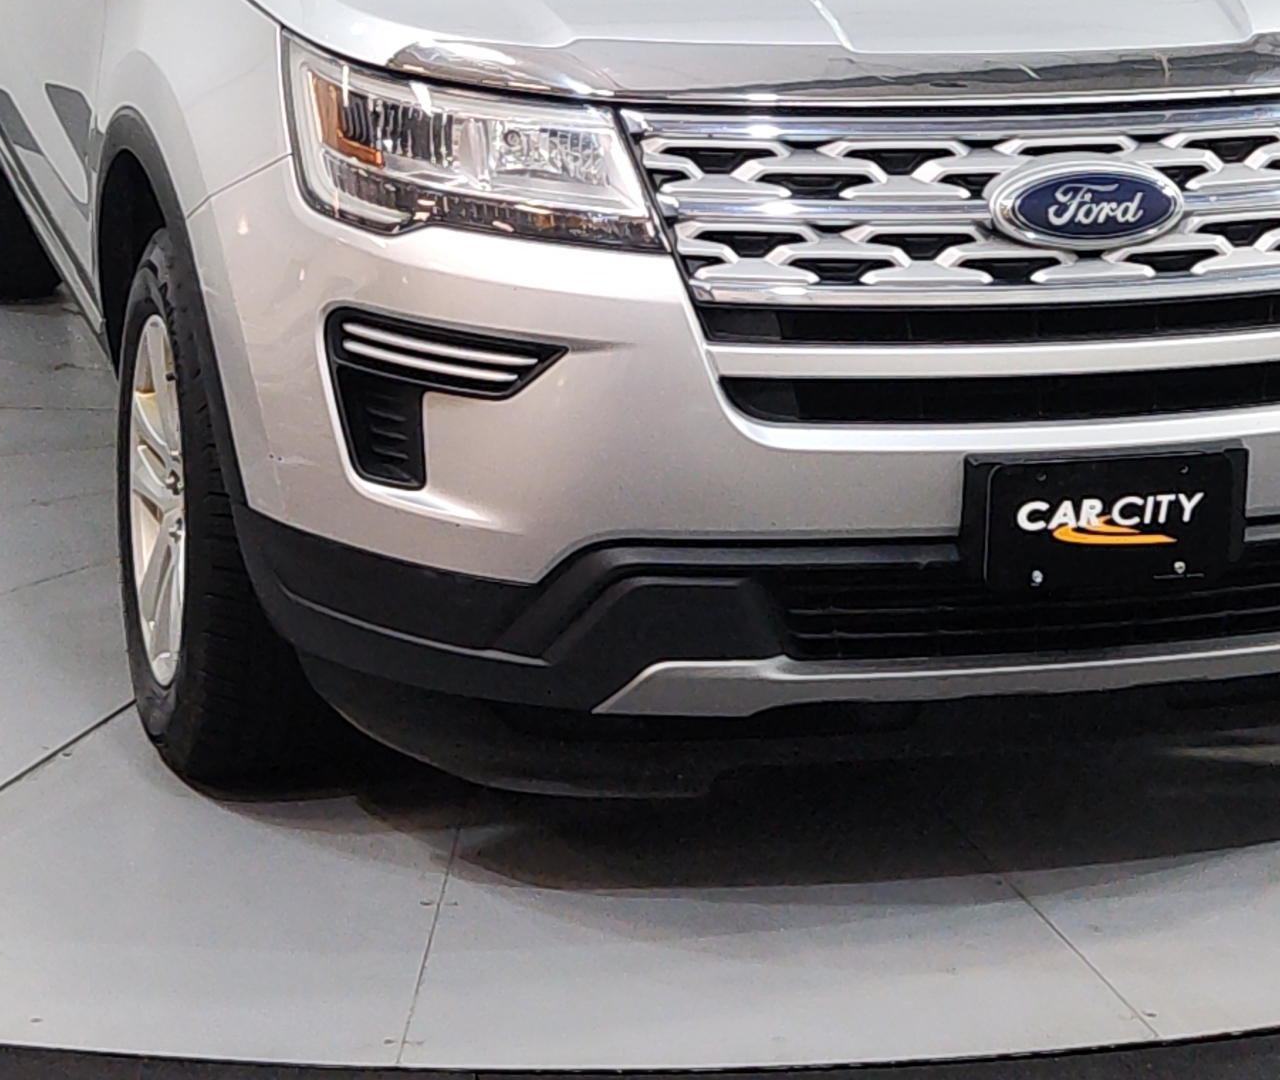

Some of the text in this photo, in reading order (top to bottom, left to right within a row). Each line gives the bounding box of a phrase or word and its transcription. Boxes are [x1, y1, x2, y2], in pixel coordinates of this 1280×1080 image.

[1048, 182, 1144, 226] Ford
[1016, 492, 1205, 532] CAR CITY
